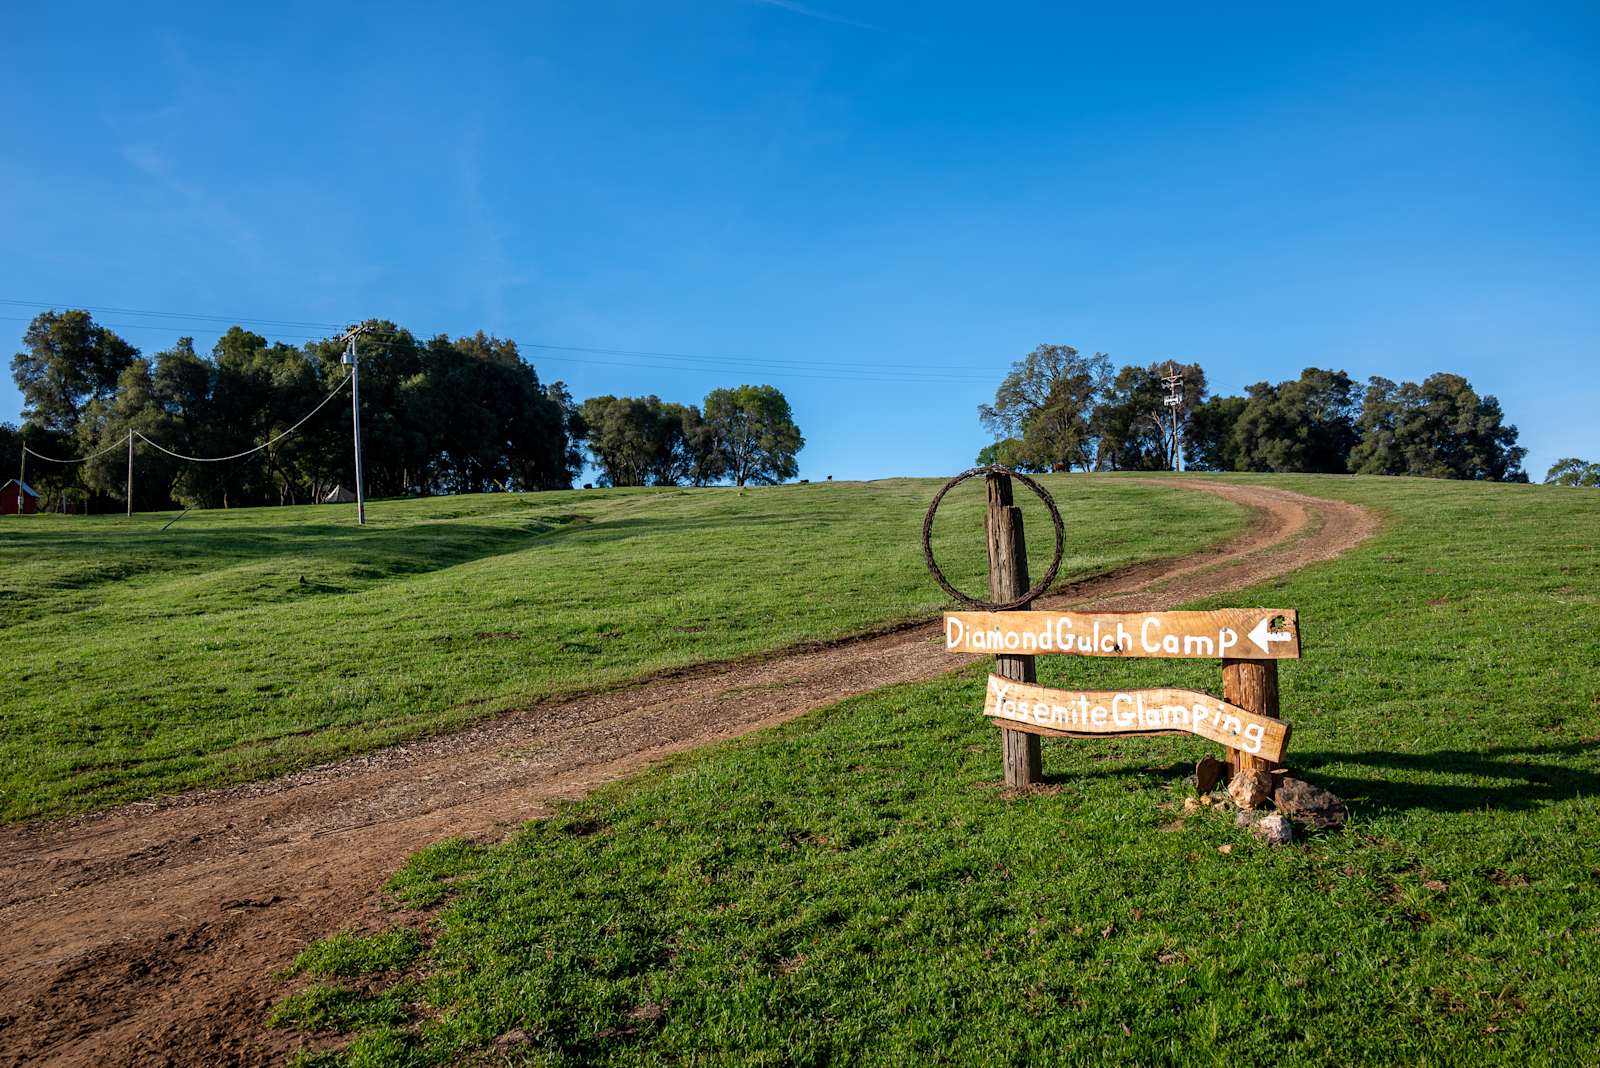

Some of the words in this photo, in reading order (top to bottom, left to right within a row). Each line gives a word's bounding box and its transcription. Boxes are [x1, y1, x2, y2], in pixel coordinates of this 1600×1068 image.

[946, 616, 1052, 650] Diamond
[1055, 616, 1134, 653] Gulch
[1141, 616, 1239, 658] Camp
[989, 678, 1109, 726] Yosemite
[1112, 692, 1265, 753] Glamping
